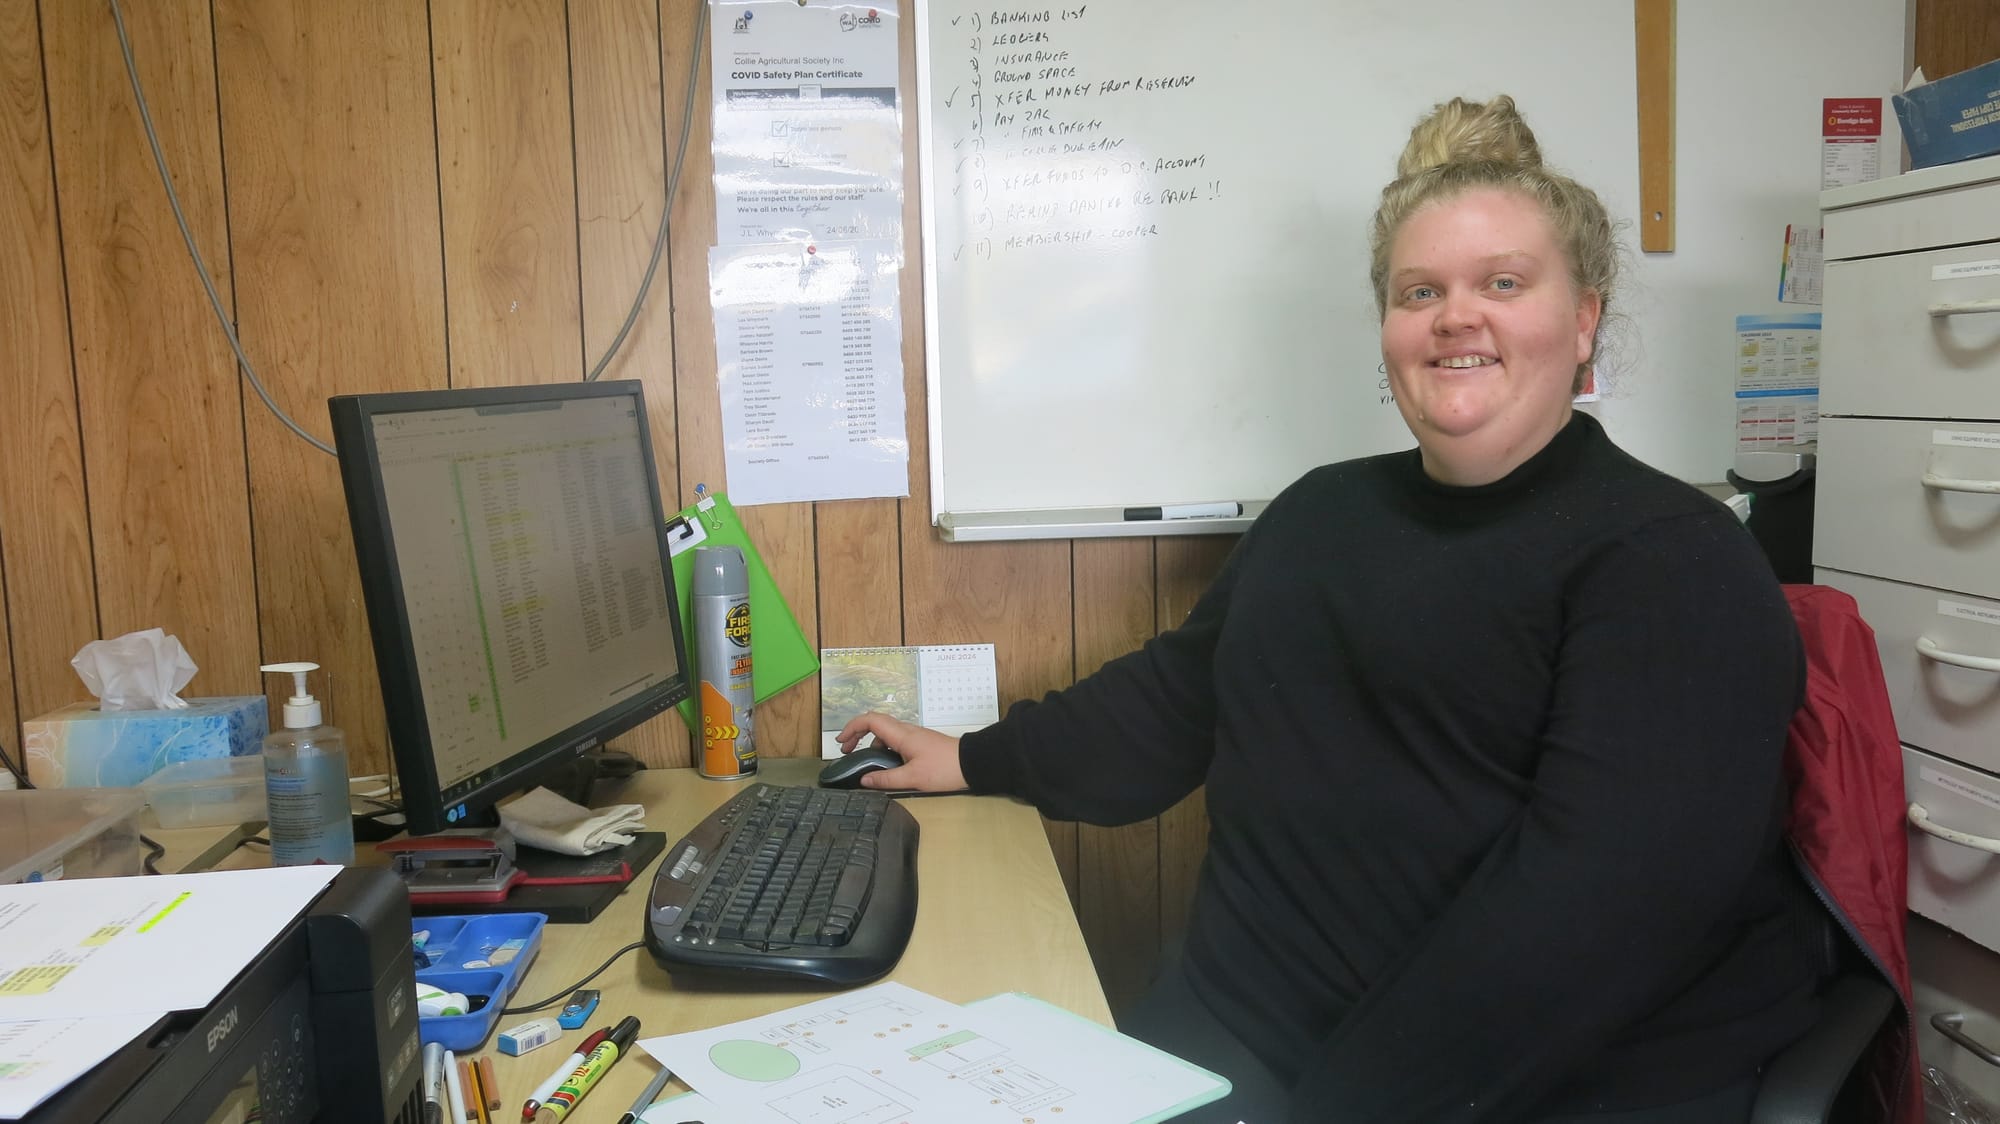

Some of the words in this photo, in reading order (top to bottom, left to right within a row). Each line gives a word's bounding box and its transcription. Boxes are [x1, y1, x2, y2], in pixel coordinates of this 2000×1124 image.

[990, 10, 1050, 25] BANKING
[1061, 5, 1086, 21] LIST
[734, 57, 756, 65] Collie
[757, 57, 800, 65] Agricultural
[802, 57, 831, 66] Society
[832, 57, 844, 65] Inc
[995, 51, 1070, 66] INSURANCE
[731, 71, 760, 79] COVID
[763, 71, 792, 80] Safety
[794, 70, 814, 79] Plan
[816, 70, 863, 79] Certificate
[1039, 67, 1075, 79] SPACE
[1046, 82, 1091, 99] MONEY
[1099, 79, 1130, 96] FROM
[994, 112, 1015, 126] PAY
[1837, 117, 1859, 125] Bendigo
[1154, 155, 1206, 174] ACCOUNT
[761, 195, 787, 203] respect
[848, 193, 865, 201] staff.
[780, 205, 794, 213] this
[936, 654, 956, 662] JUNE
[207, 1004, 238, 1053] EPSON
